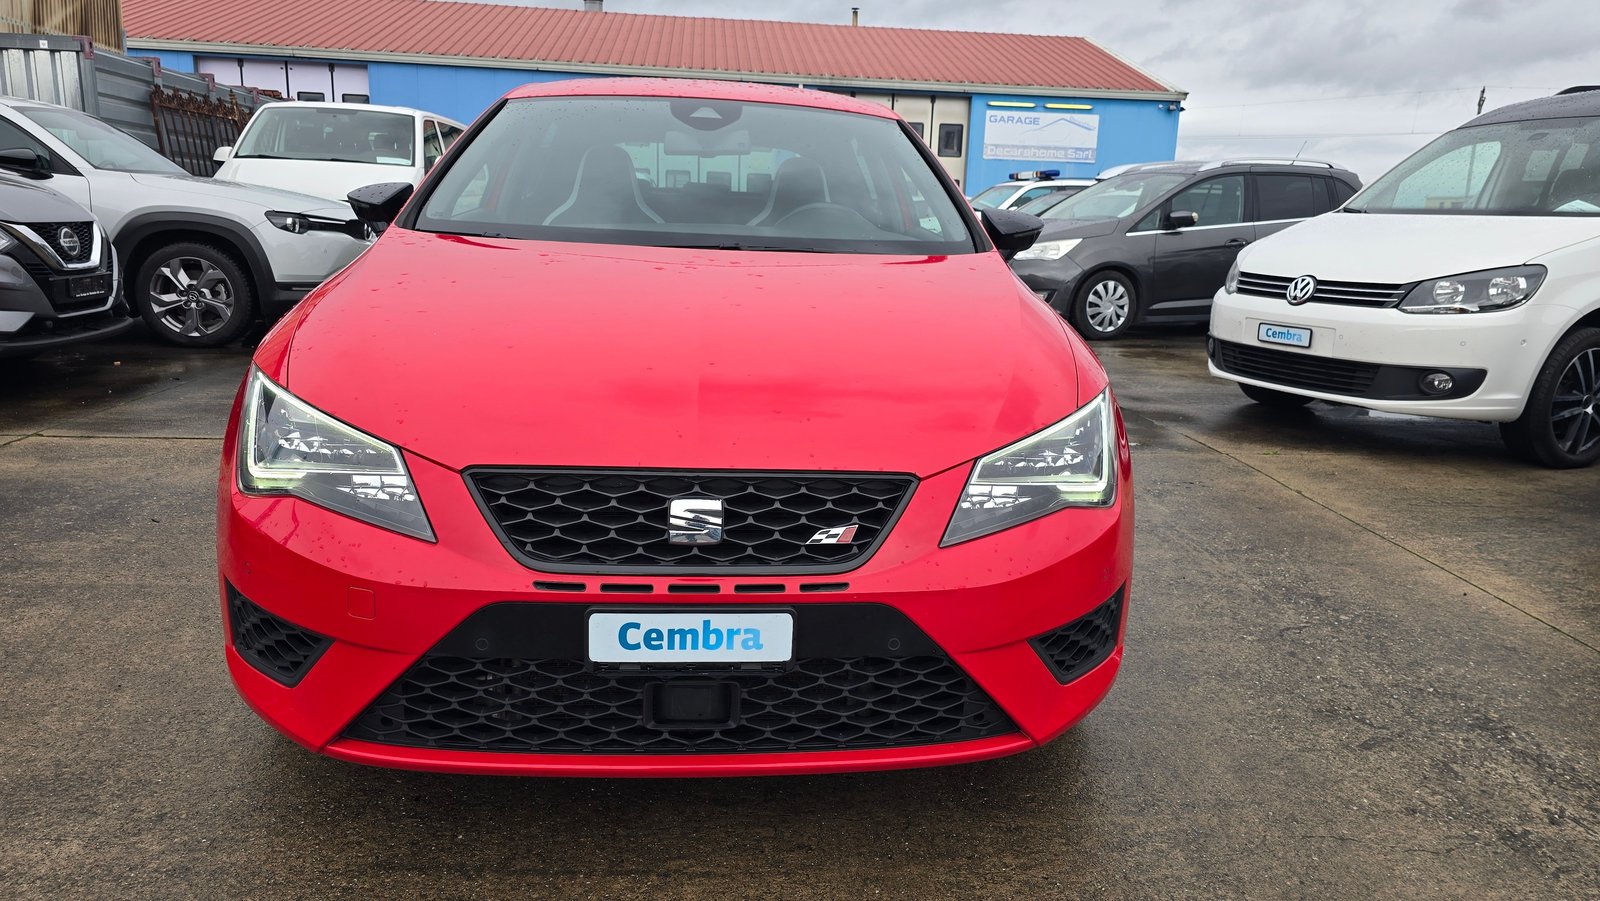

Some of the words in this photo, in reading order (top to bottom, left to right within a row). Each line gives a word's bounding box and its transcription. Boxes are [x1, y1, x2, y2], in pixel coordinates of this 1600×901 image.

[989, 114, 1040, 126] GARAGE
[1067, 149, 1093, 159] Sarl
[1265, 327, 1303, 342] Cembra
[618, 619, 764, 651] Cembra
